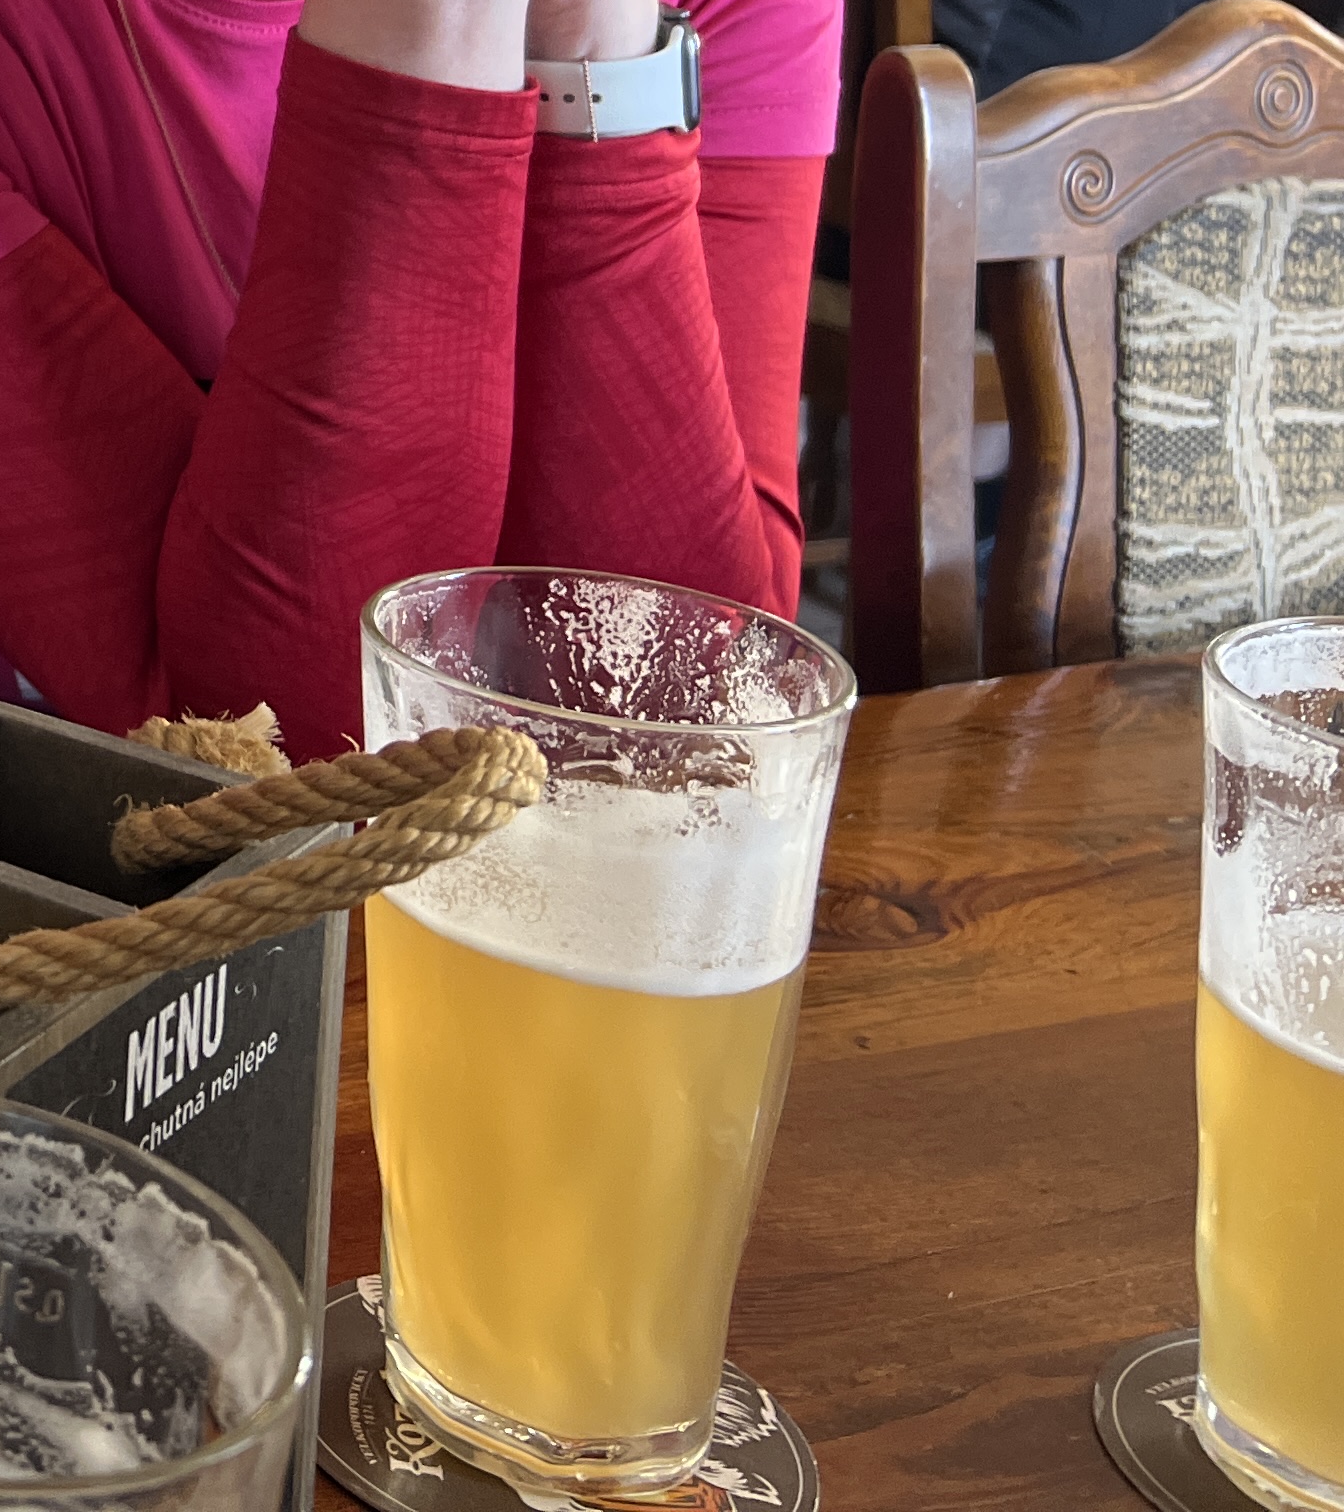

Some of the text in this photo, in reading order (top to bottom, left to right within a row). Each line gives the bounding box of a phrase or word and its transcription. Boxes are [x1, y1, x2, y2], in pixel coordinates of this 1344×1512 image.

[124, 962, 228, 1126] MENU
[138, 1031, 279, 1153] chutná nejlépe
